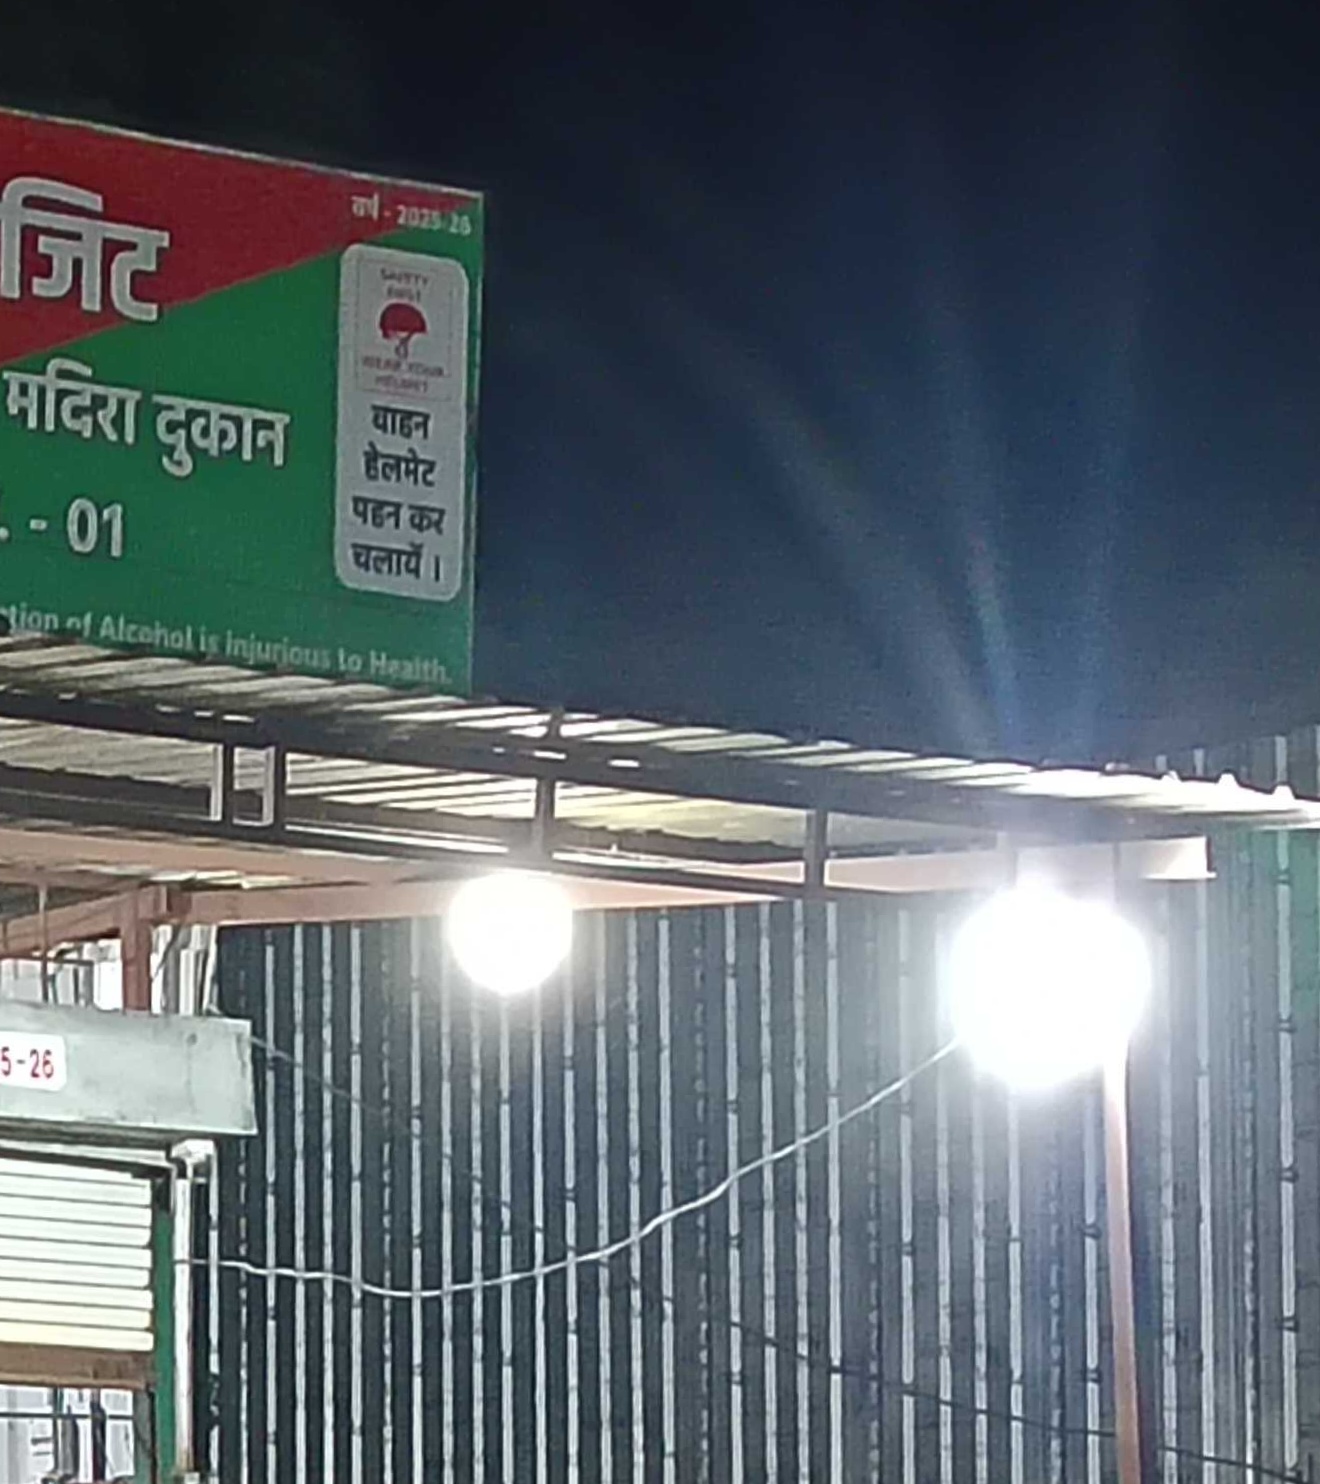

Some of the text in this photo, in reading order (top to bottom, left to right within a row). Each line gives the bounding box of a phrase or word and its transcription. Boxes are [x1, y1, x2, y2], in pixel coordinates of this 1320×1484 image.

[2, 357, 142, 445] मदिरा
[152, 393, 291, 477] दुकान
[371, 404, 430, 440] वाहन
[363, 440, 436, 487] हेलमेट
[66, 497, 124, 557] 01
[352, 495, 446, 535] पहन कर
[100, 614, 193, 651] Alcohol
[337, 648, 361, 672] to
